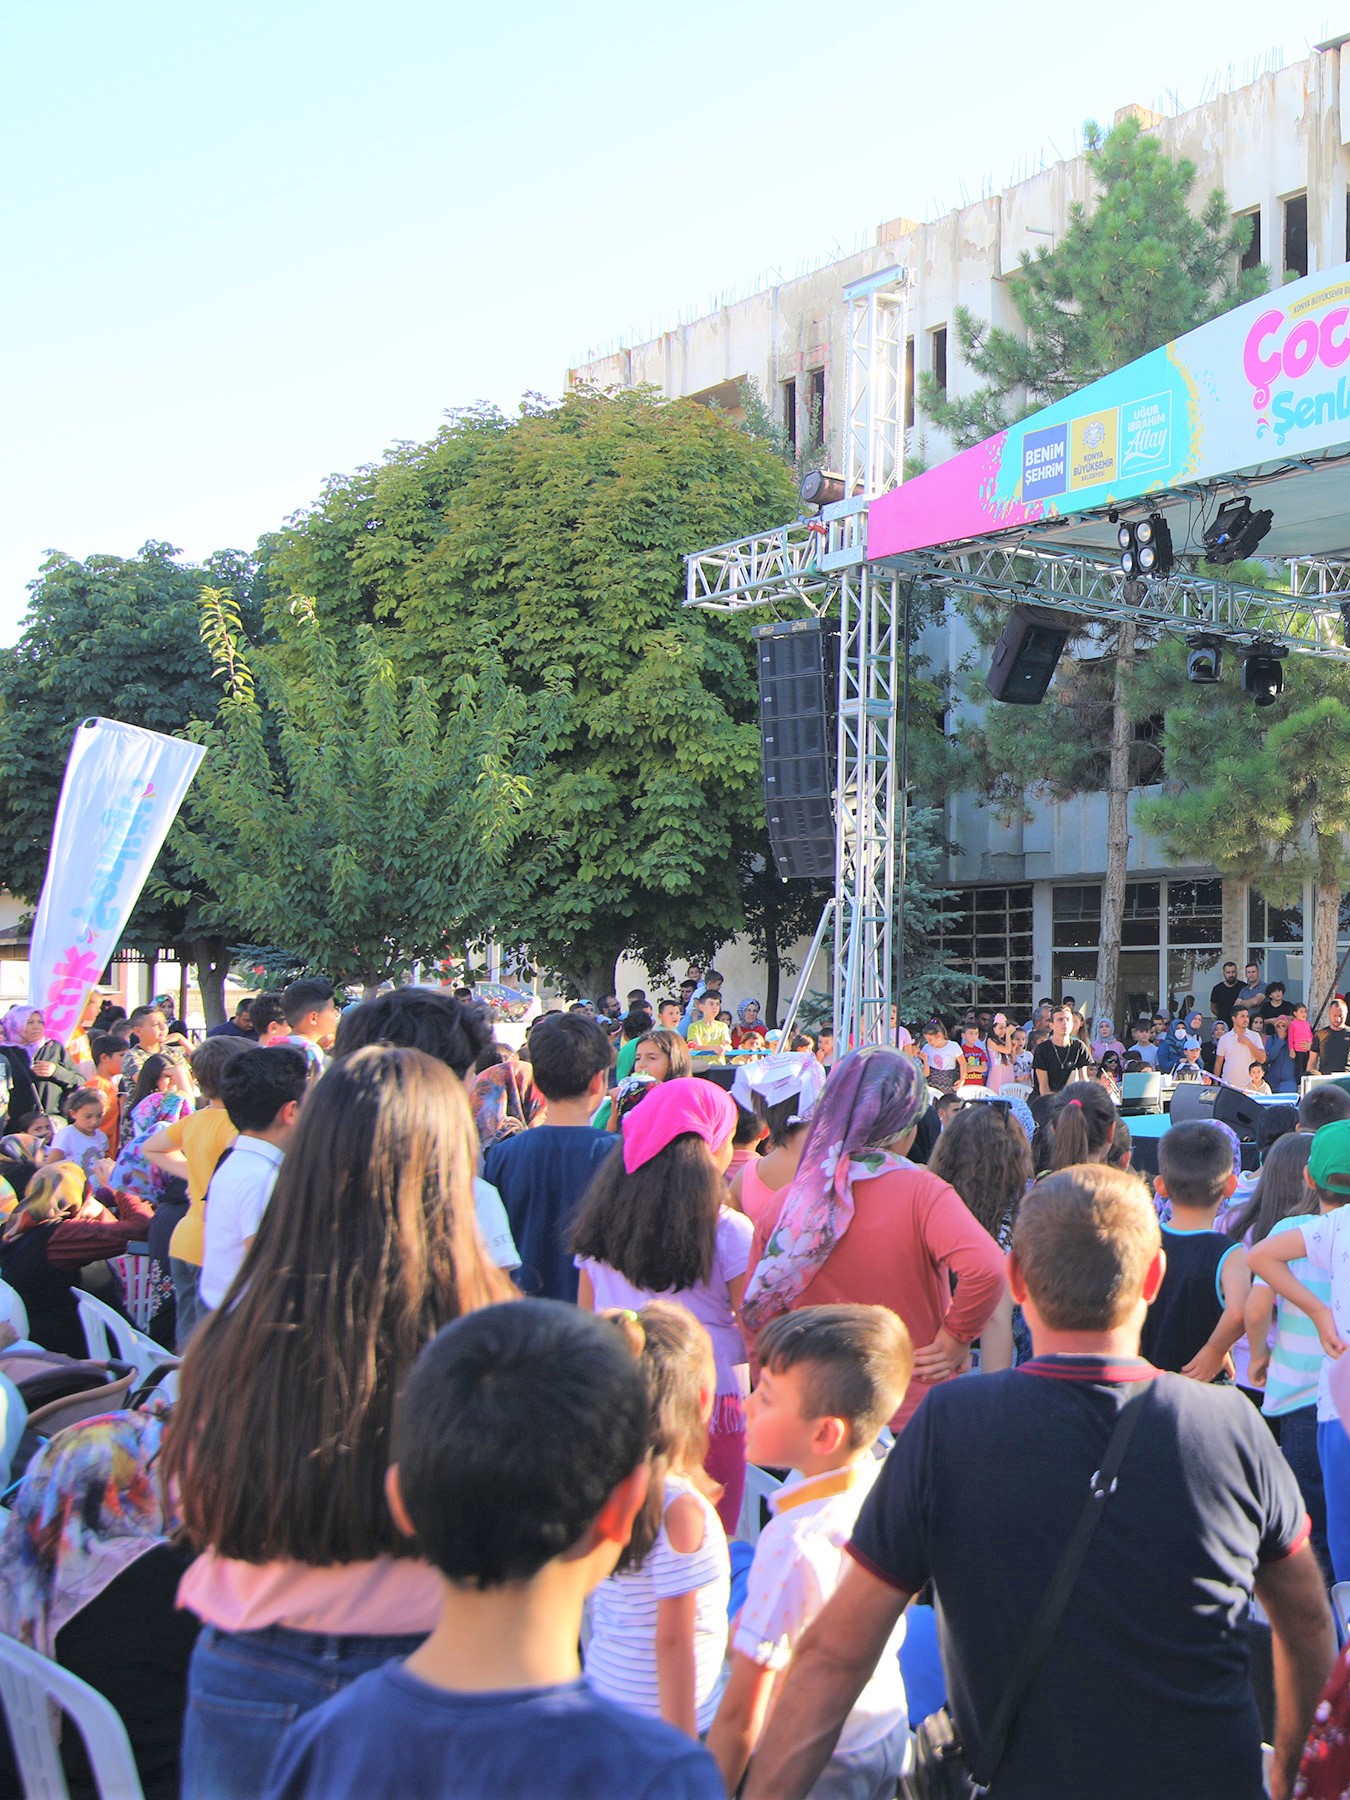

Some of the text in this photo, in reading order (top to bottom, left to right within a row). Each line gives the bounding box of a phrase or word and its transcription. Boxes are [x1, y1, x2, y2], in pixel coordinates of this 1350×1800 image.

[1294, 300, 1311, 314] KONYA
[1311, 287, 1344, 306] BÜYÜKŞEHİR
[1133, 405, 1159, 421] UĞUR
[1123, 428, 1167, 466] Altay
[1083, 451, 1104, 462] KONYA
[1073, 458, 1114, 476] BÜYÜKŞEHİR
